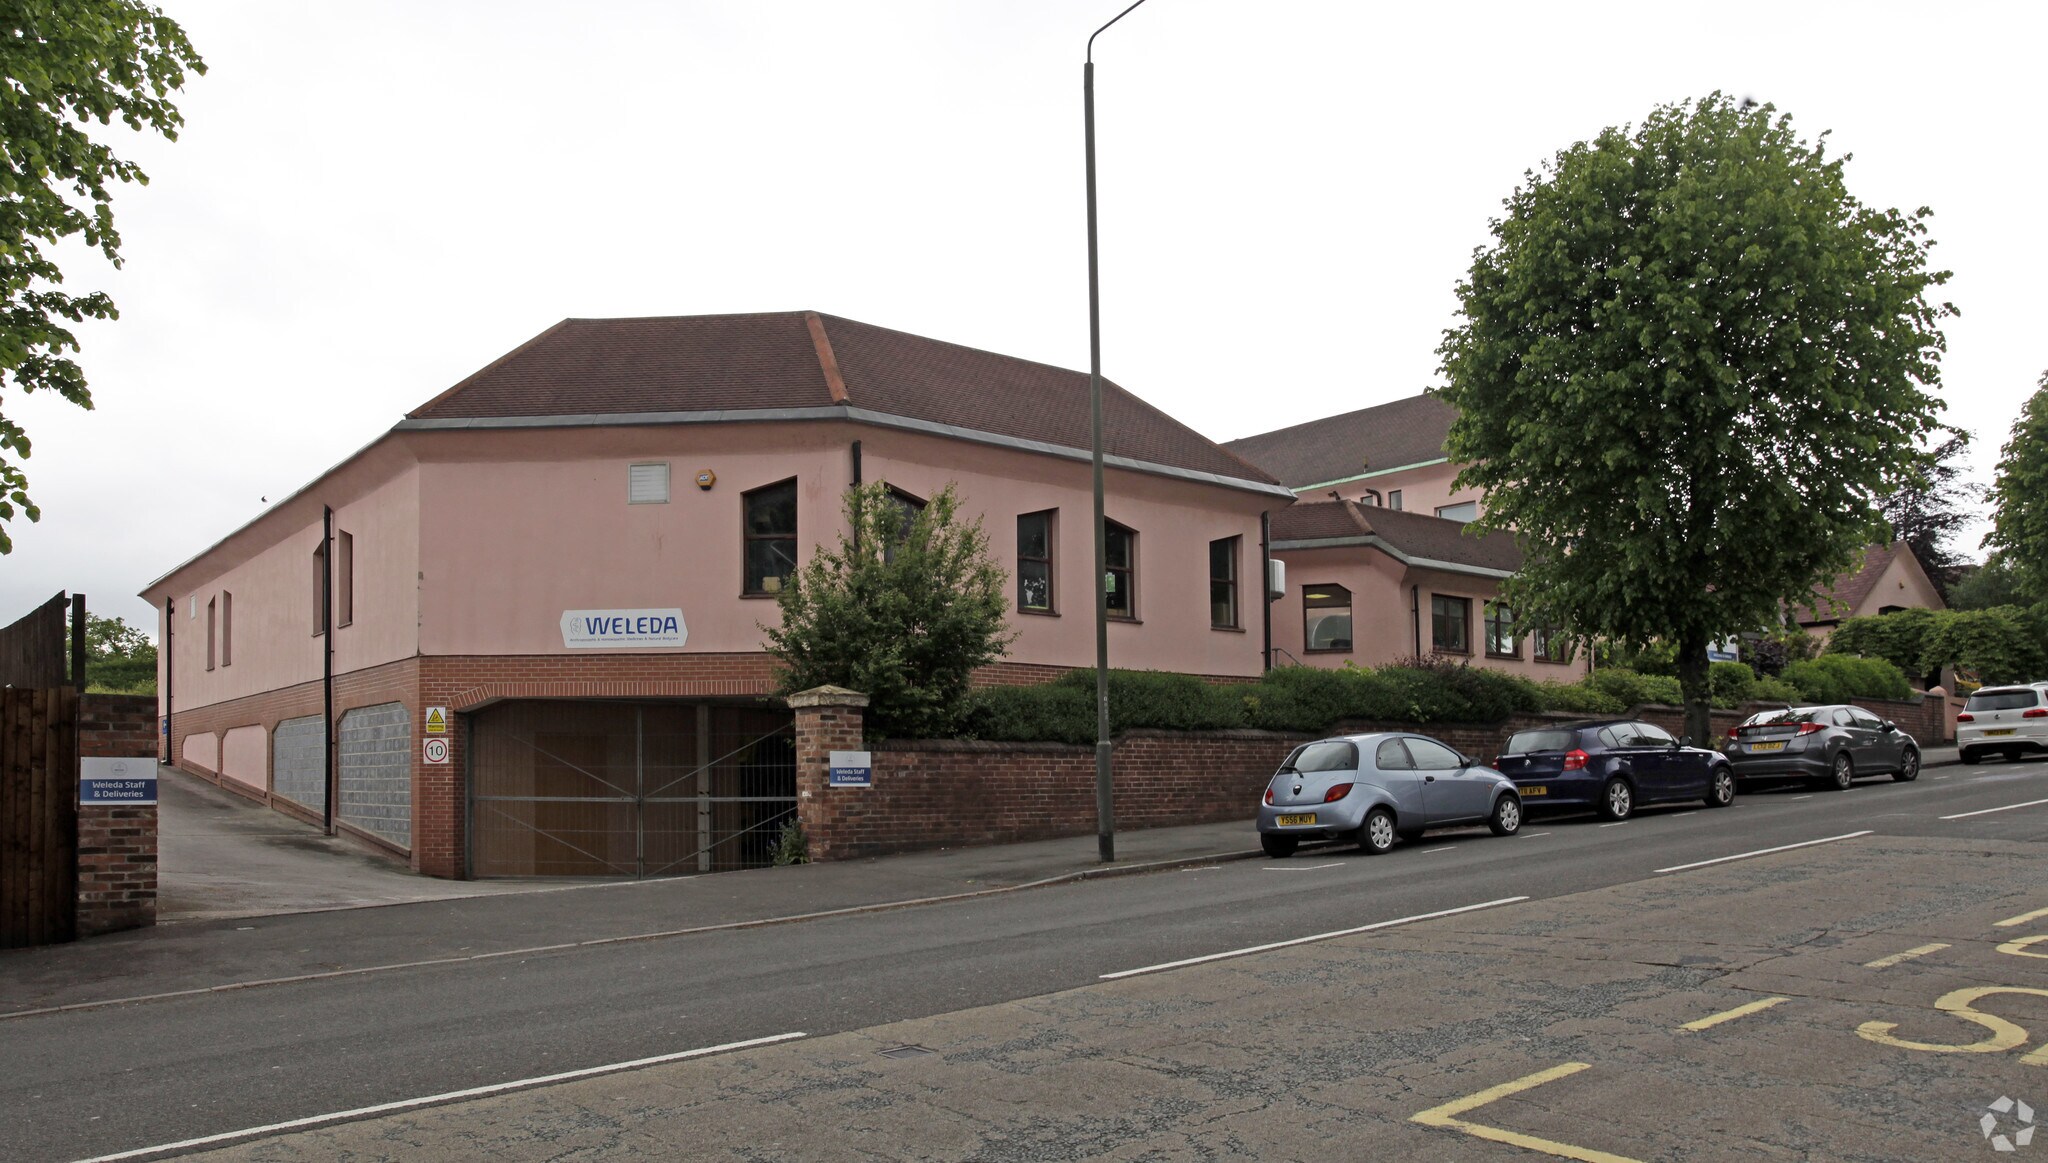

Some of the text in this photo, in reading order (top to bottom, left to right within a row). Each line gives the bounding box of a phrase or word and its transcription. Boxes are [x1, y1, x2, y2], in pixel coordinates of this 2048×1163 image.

[585, 617, 678, 635] WELEDA
[429, 745, 443, 756] 10
[92, 781, 146, 789] Weleda Staff
[94, 790, 144, 798] & Deliveries
